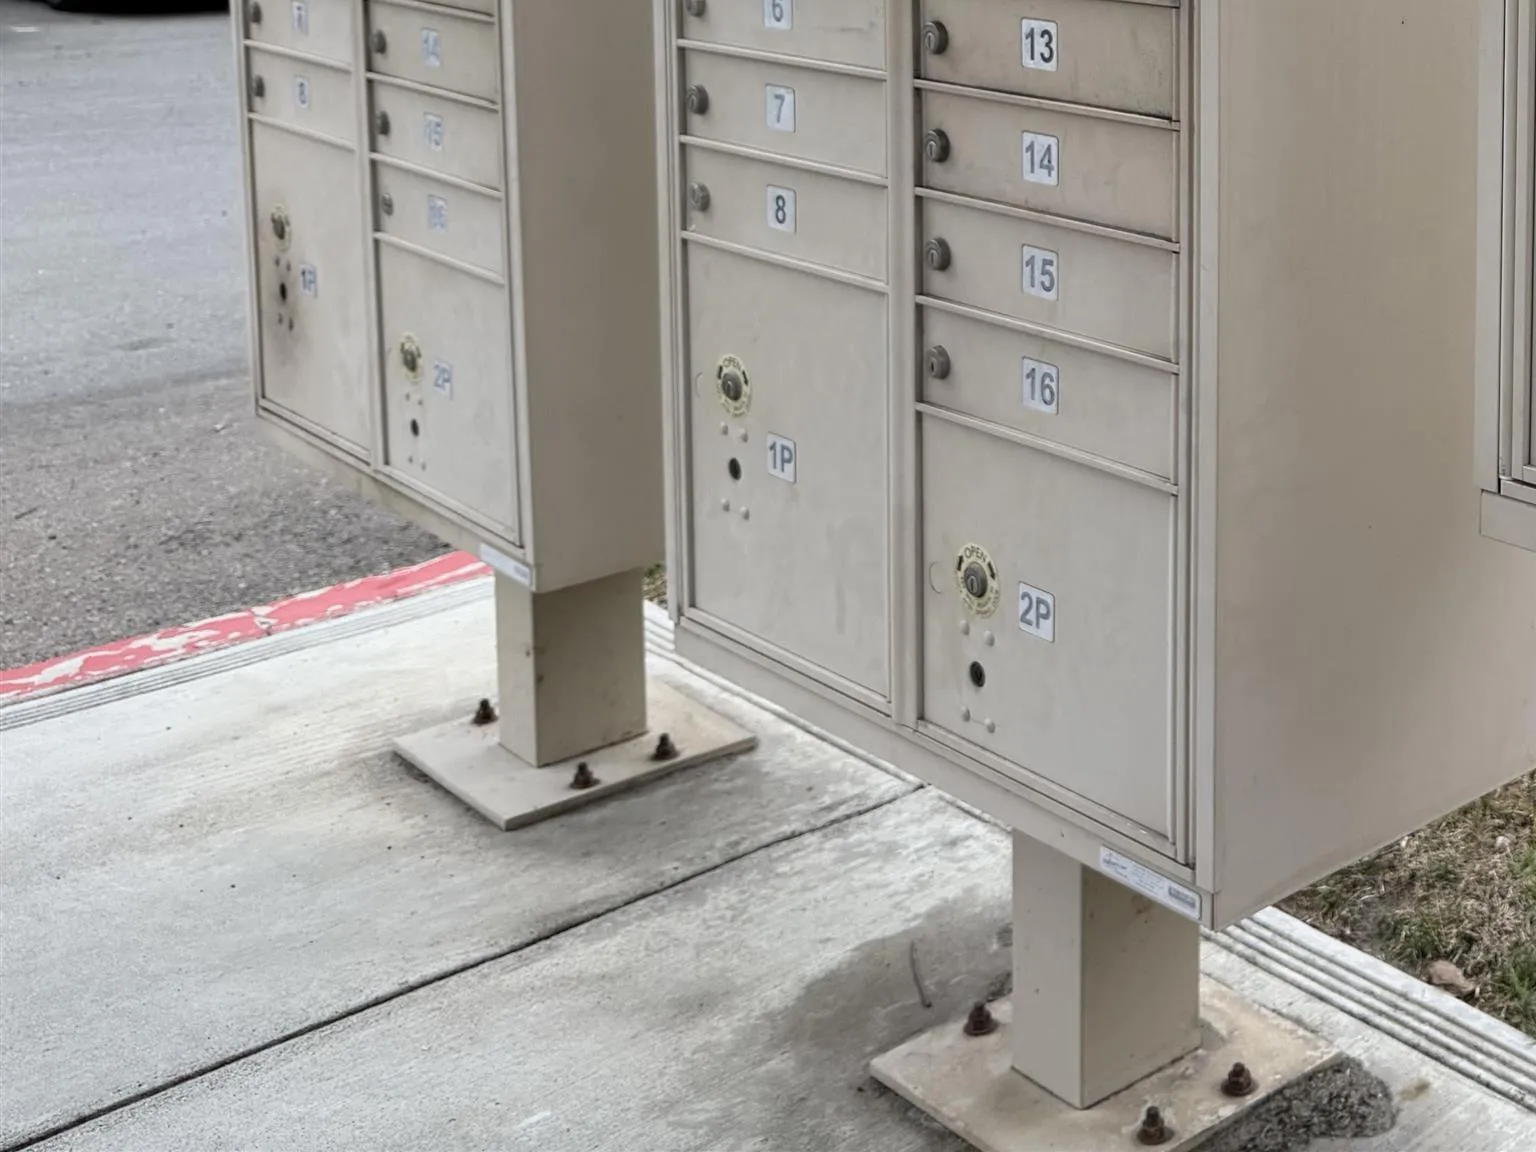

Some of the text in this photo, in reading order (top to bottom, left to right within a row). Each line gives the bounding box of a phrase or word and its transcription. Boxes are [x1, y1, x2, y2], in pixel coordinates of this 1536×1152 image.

[1025, 27, 1054, 64] 13
[772, 93, 788, 125] 7
[1024, 140, 1055, 178] 14
[774, 194, 787, 225] 8
[1024, 253, 1056, 294] 15
[1025, 366, 1056, 407] 16
[768, 440, 794, 474] 1P
[1019, 590, 1051, 631] 2P
